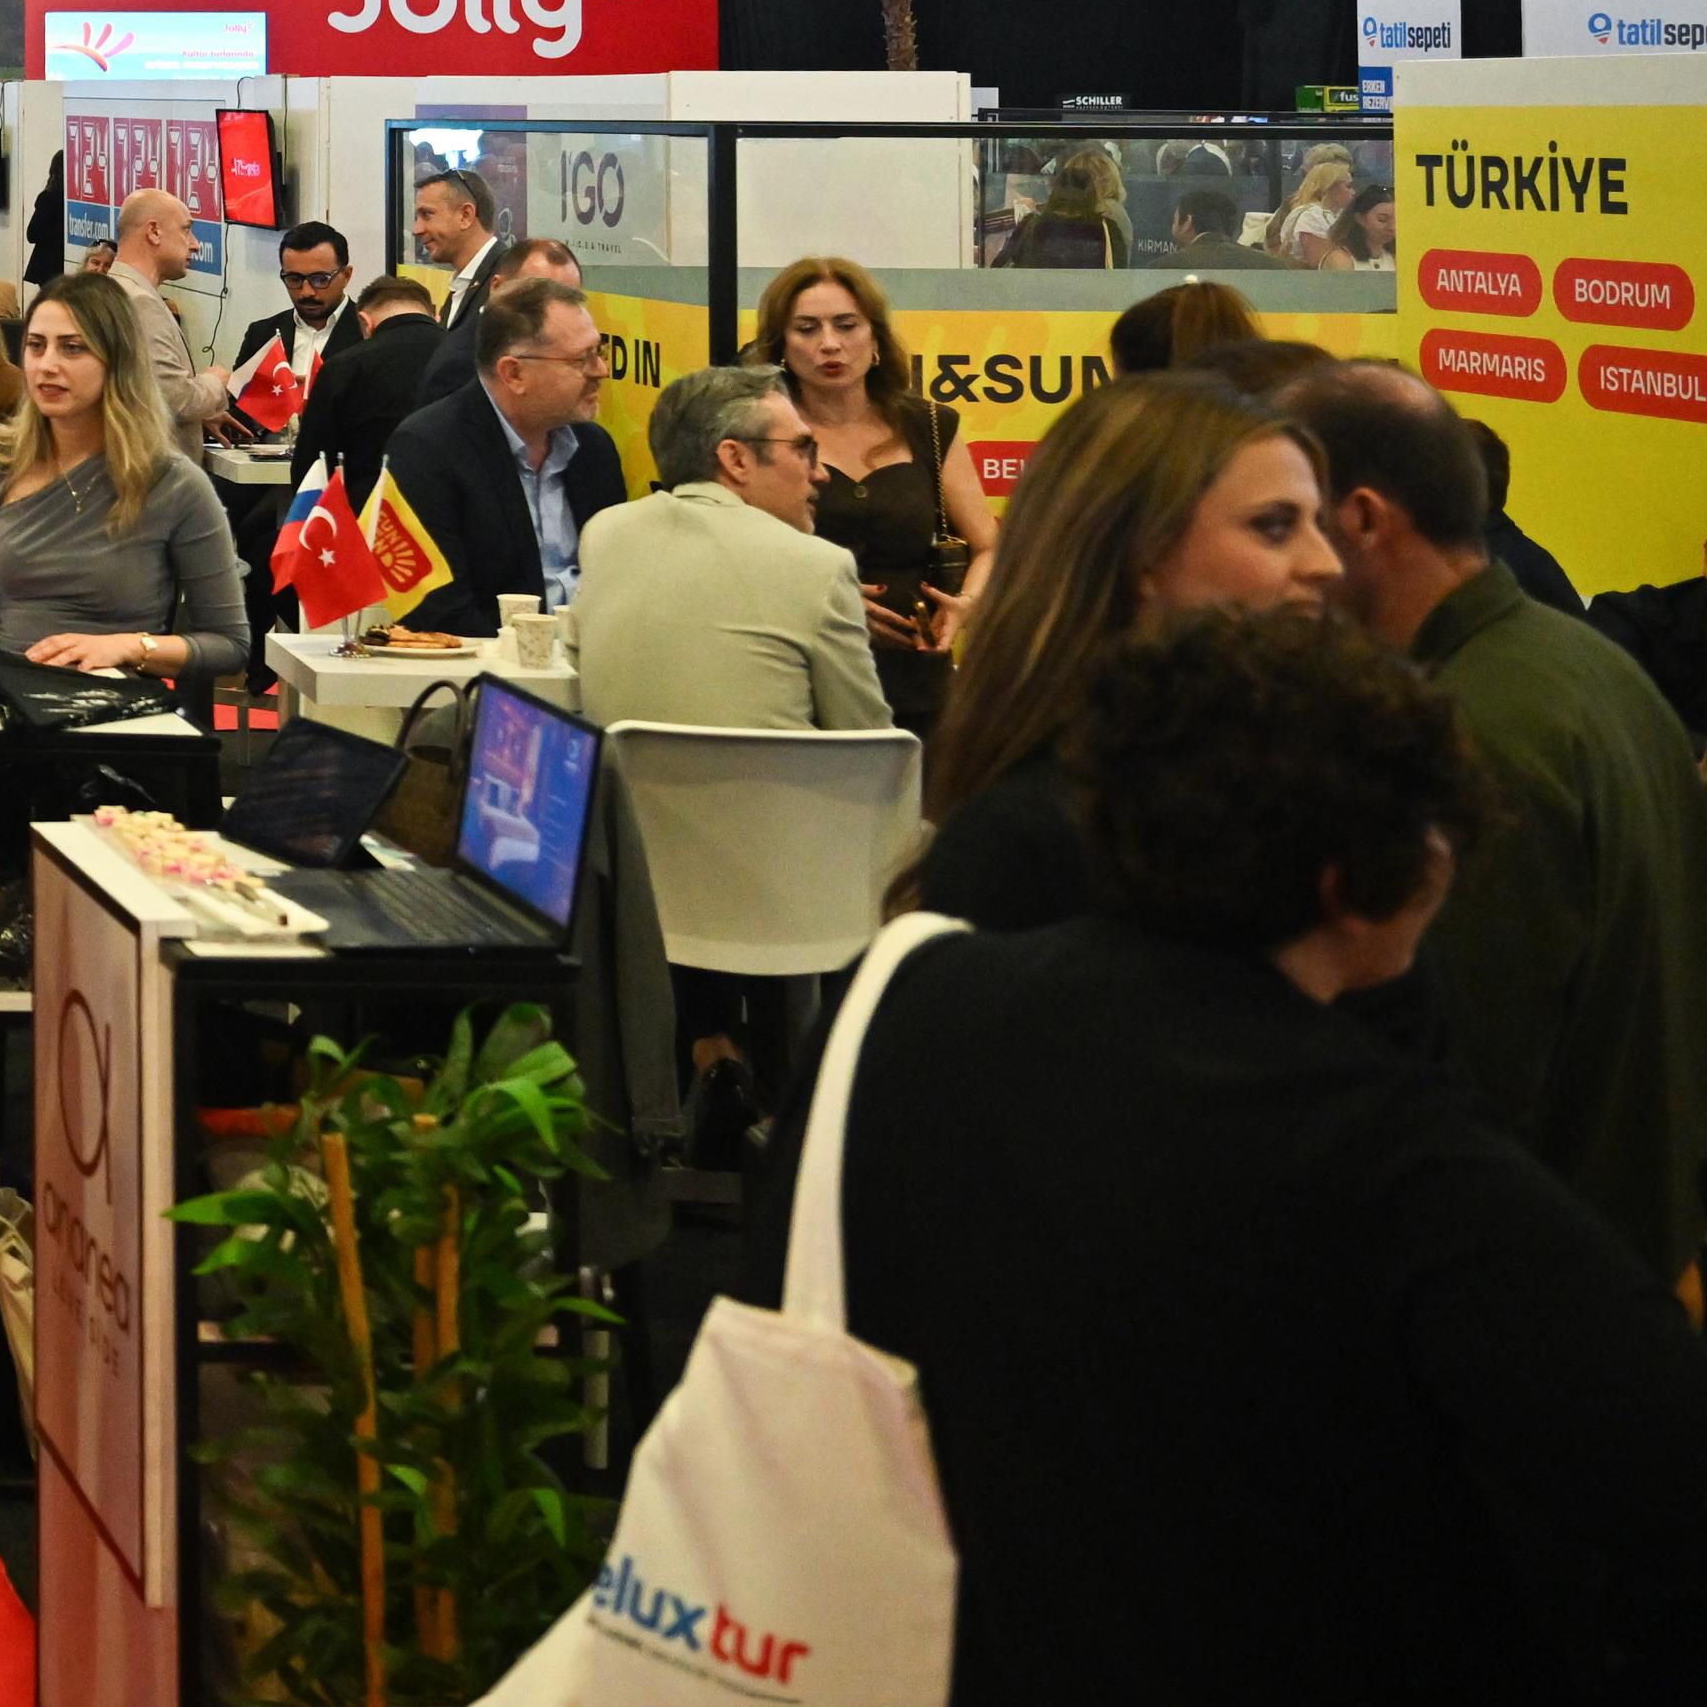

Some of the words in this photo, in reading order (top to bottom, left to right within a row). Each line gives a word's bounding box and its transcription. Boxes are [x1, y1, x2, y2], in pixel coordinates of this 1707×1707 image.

[1380, 22, 1451, 52] tatilsepeti
[1617, 19, 1707, 50] tatilsep
[1075, 96, 1123, 105] SCHILLER
[1415, 139, 1629, 215] TÜRKİYE
[68, 212, 109, 239] transfer.com
[1436, 268, 1522, 298] ANTALYA
[1574, 278, 1671, 311] BODRUM
[635, 339, 661, 389] IN
[1438, 347, 1546, 383] MARMARIS
